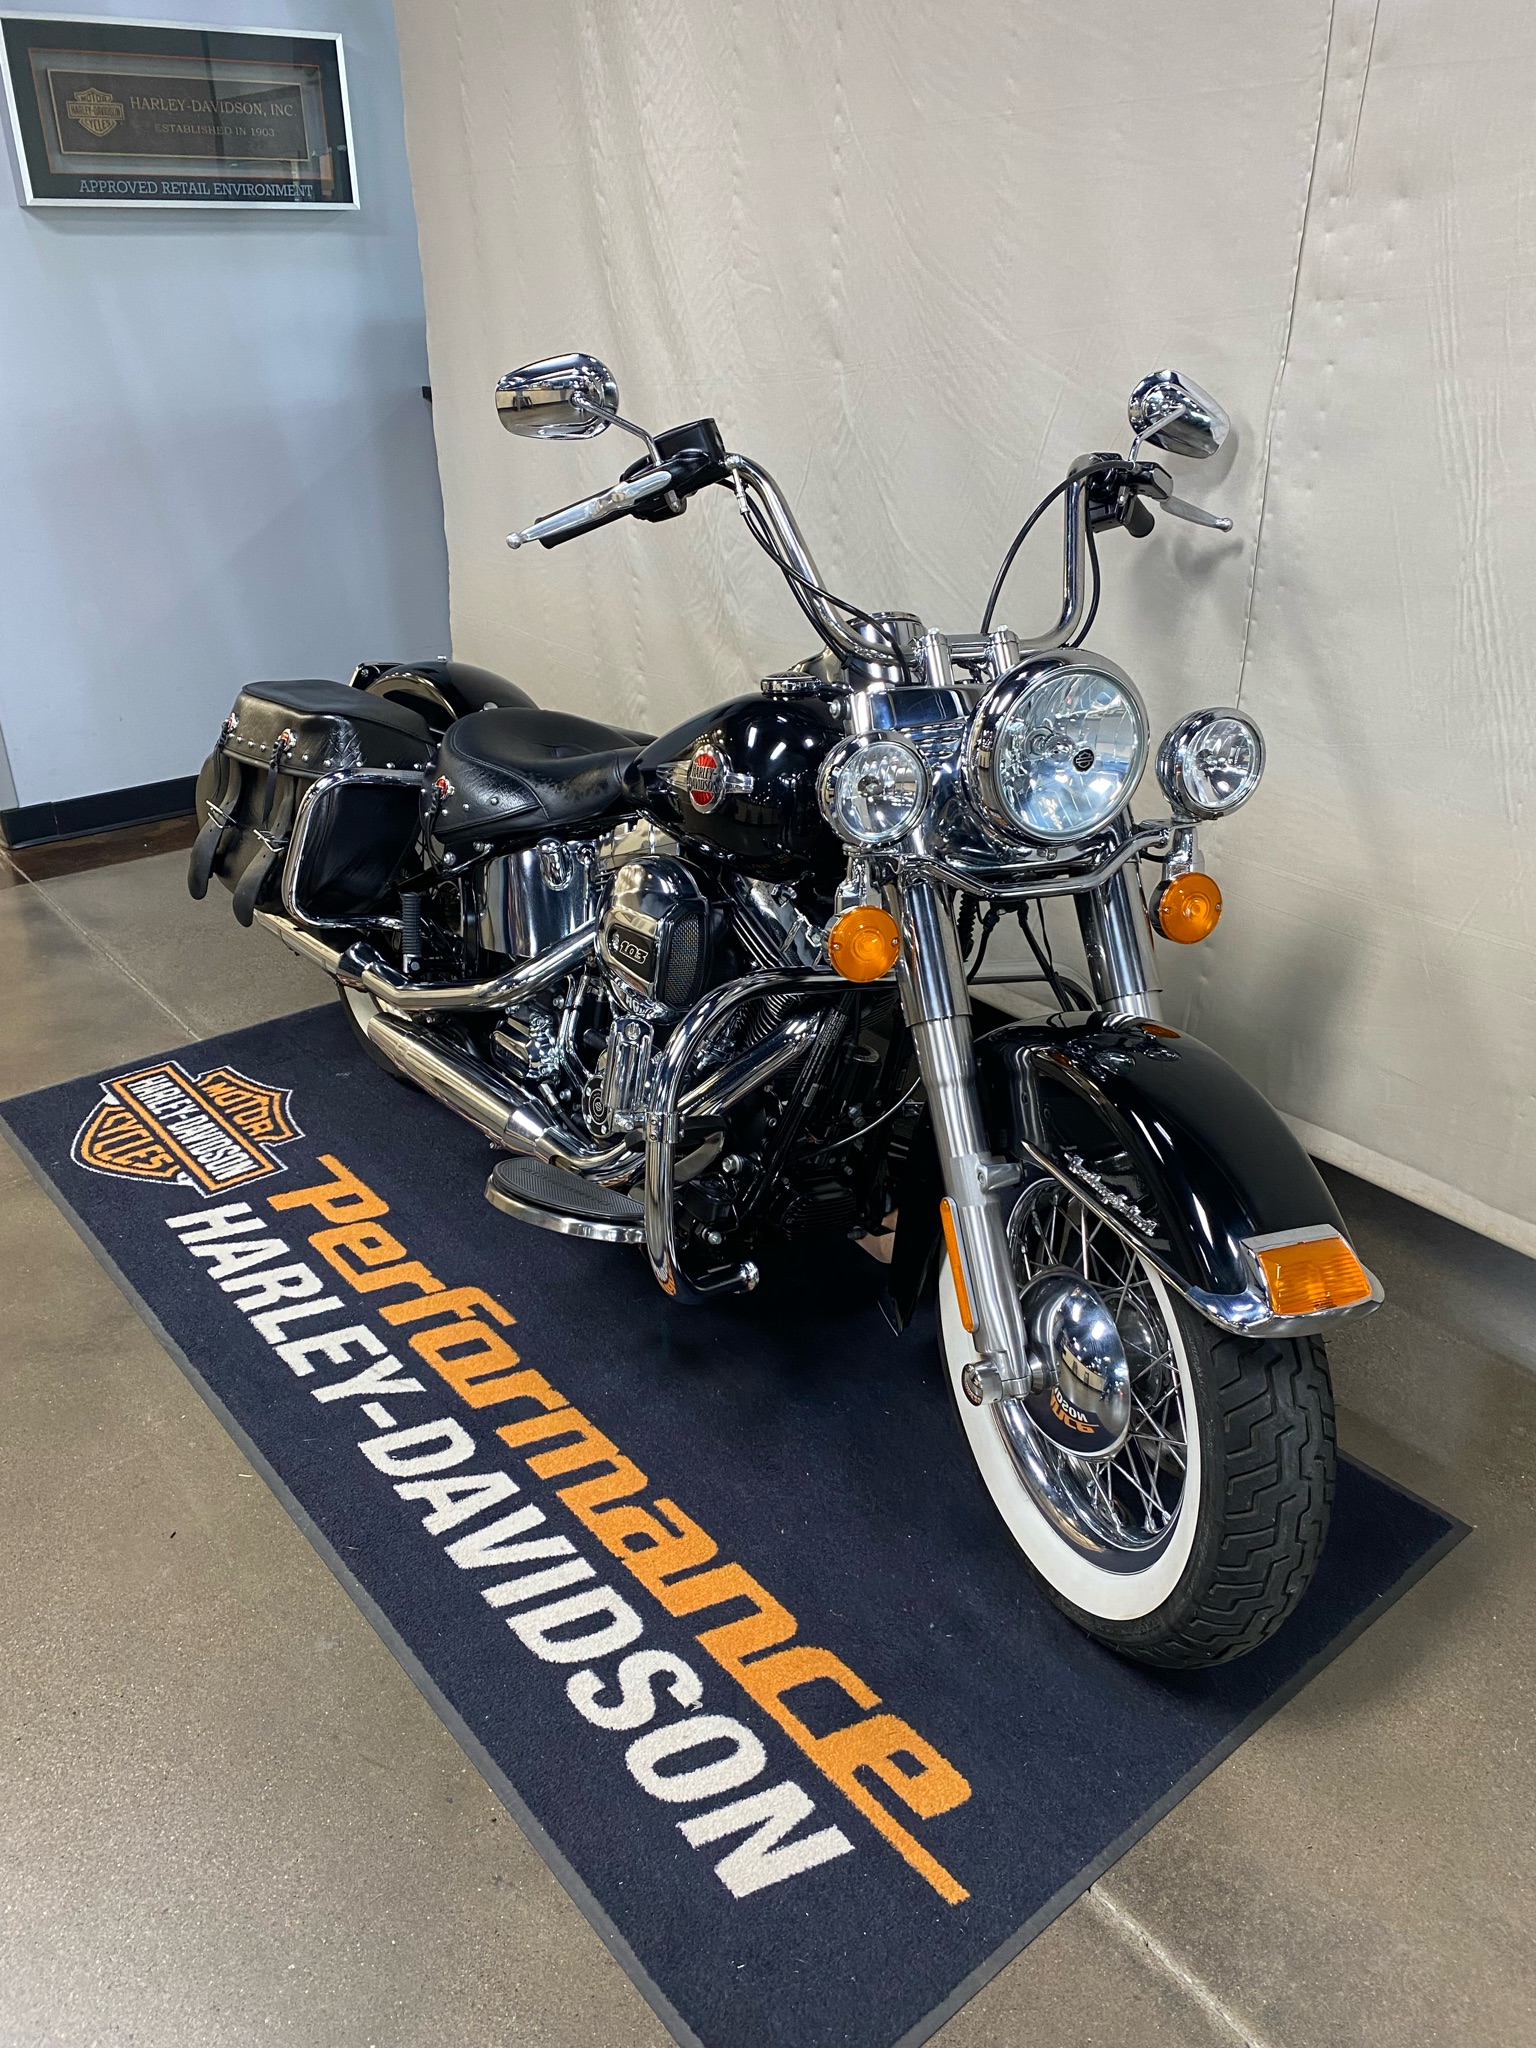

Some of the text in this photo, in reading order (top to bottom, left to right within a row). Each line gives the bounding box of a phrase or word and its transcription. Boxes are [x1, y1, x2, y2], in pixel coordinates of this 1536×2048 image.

[80, 94, 108, 104] MOTOR
[70, 105, 123, 117] HARLEY-DAVIDSON
[270, 104, 298, 117] INC.
[82, 118, 115, 131] CYCLES
[154, 123, 276, 138] ESTABLISHED IN 1903
[79, 179, 313, 197] APPROVED RETAIL ENVIRONMENT
[619, 941, 649, 965] 103
[203, 1081, 276, 1139] MOTOR
[126, 1074, 259, 1181] HARLEY-DAVIDSON
[93, 1110, 175, 1170] CYCLES
[266, 1154, 973, 1906] Performance
[164, 1202, 855, 1899] HARLEY-DAVIDSON
